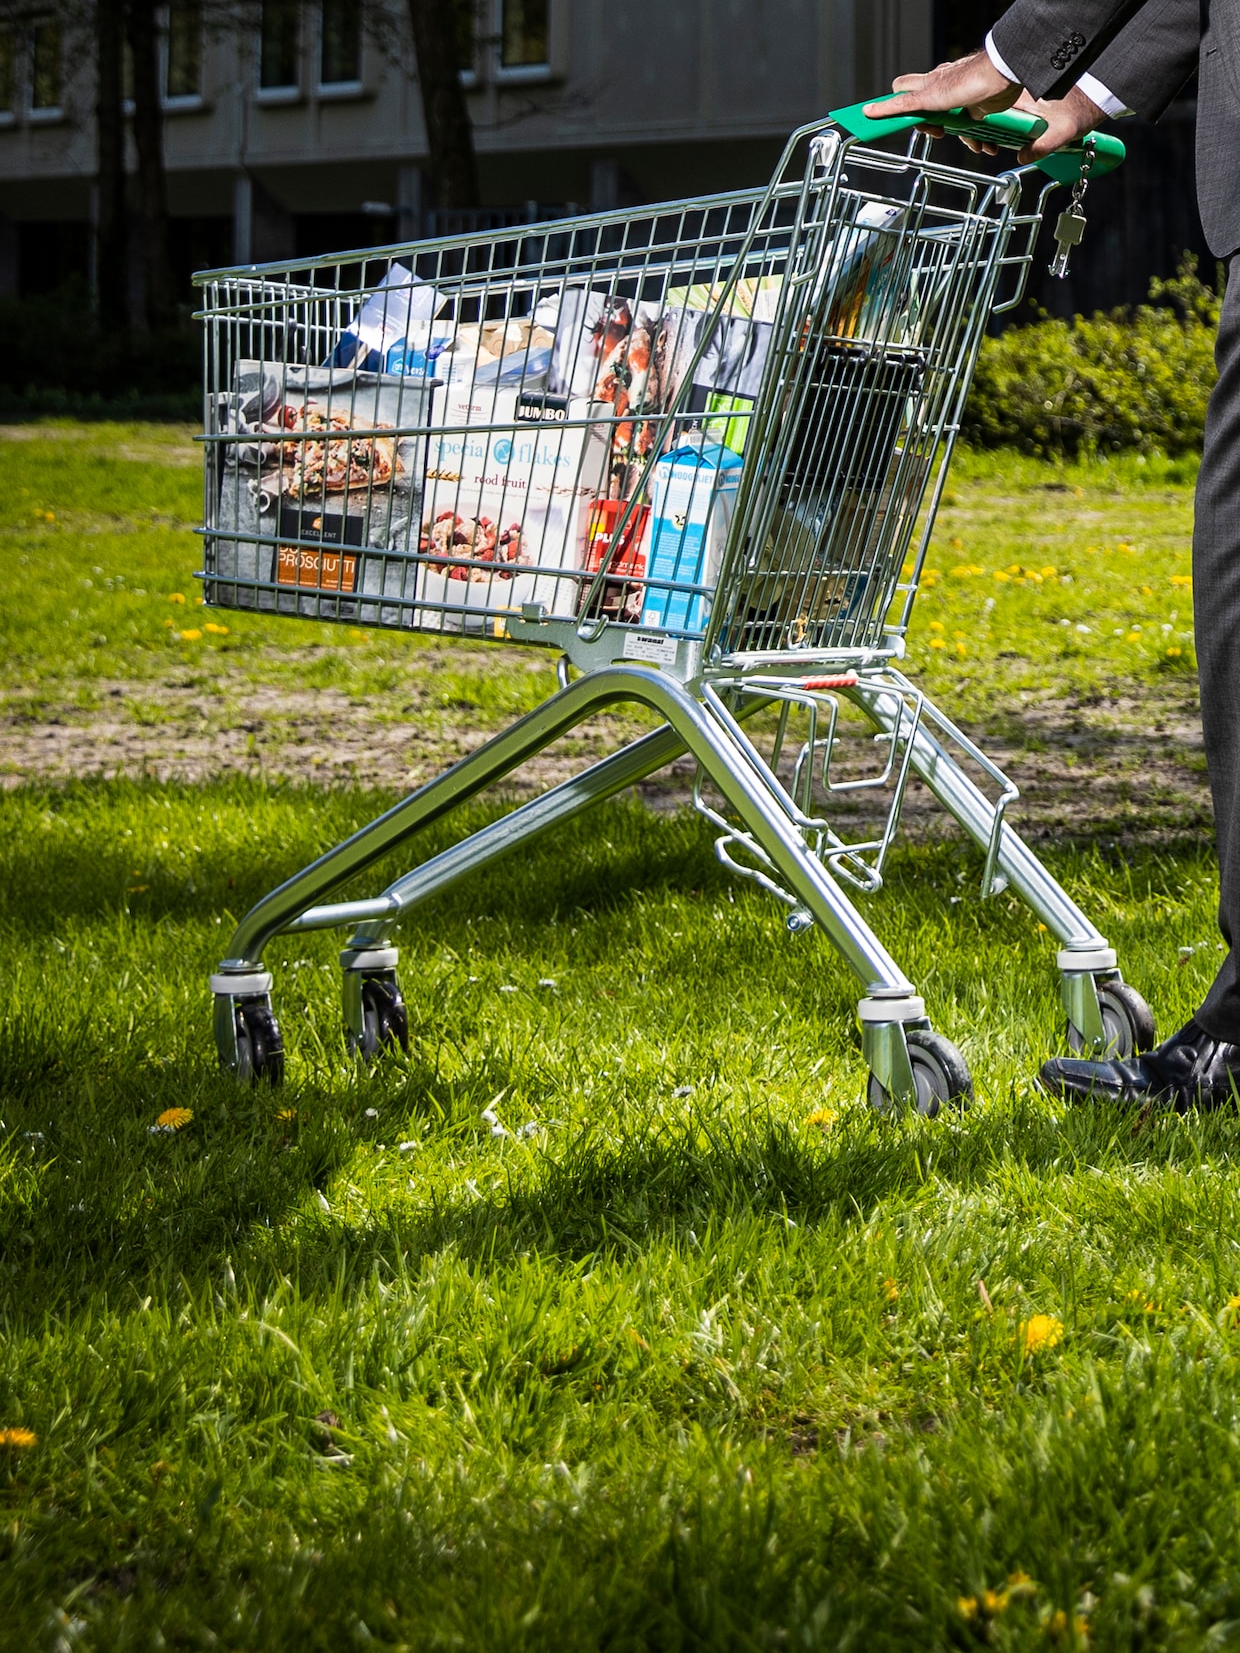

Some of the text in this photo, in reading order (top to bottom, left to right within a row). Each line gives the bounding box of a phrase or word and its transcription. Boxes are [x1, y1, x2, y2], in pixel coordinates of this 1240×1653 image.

[458, 403, 482, 412] vetrm
[518, 405, 566, 421] JUMBO
[434, 439, 571, 467] specia flakes
[474, 475, 527, 489] rood fruit
[670, 470, 714, 484] HOOGLIET
[302, 529, 337, 538] EXCELENT
